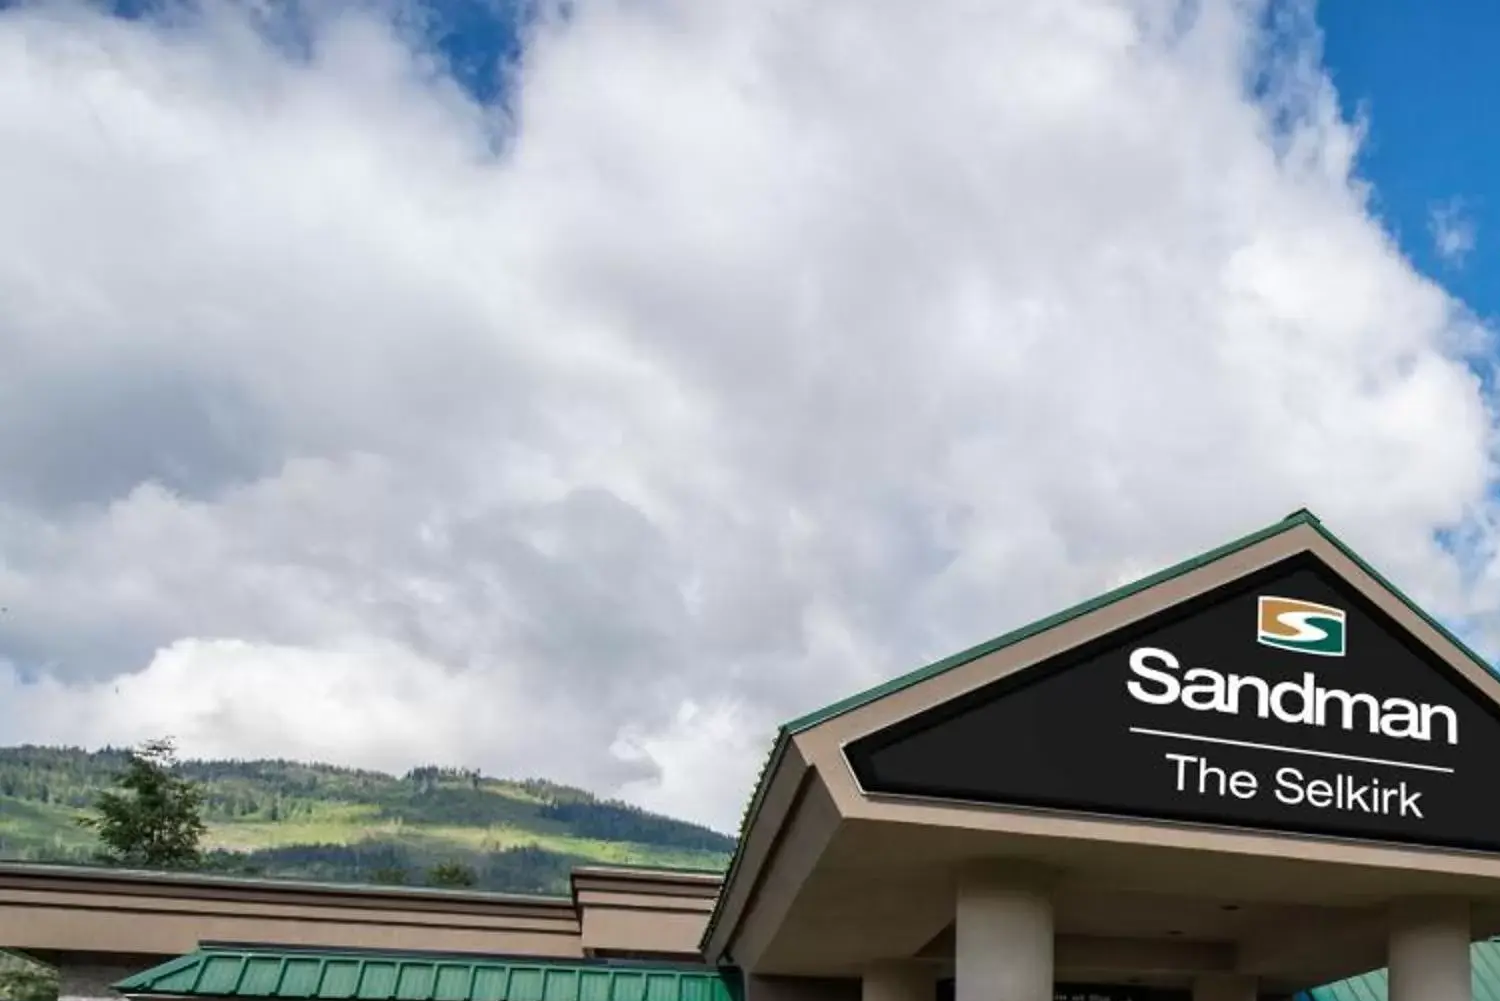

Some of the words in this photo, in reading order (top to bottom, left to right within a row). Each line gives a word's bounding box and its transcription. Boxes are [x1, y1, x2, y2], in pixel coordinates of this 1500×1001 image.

[1127, 647, 1458, 745] Sandman
[1165, 752, 1258, 799] The
[1275, 767, 1424, 819] Selkirk
